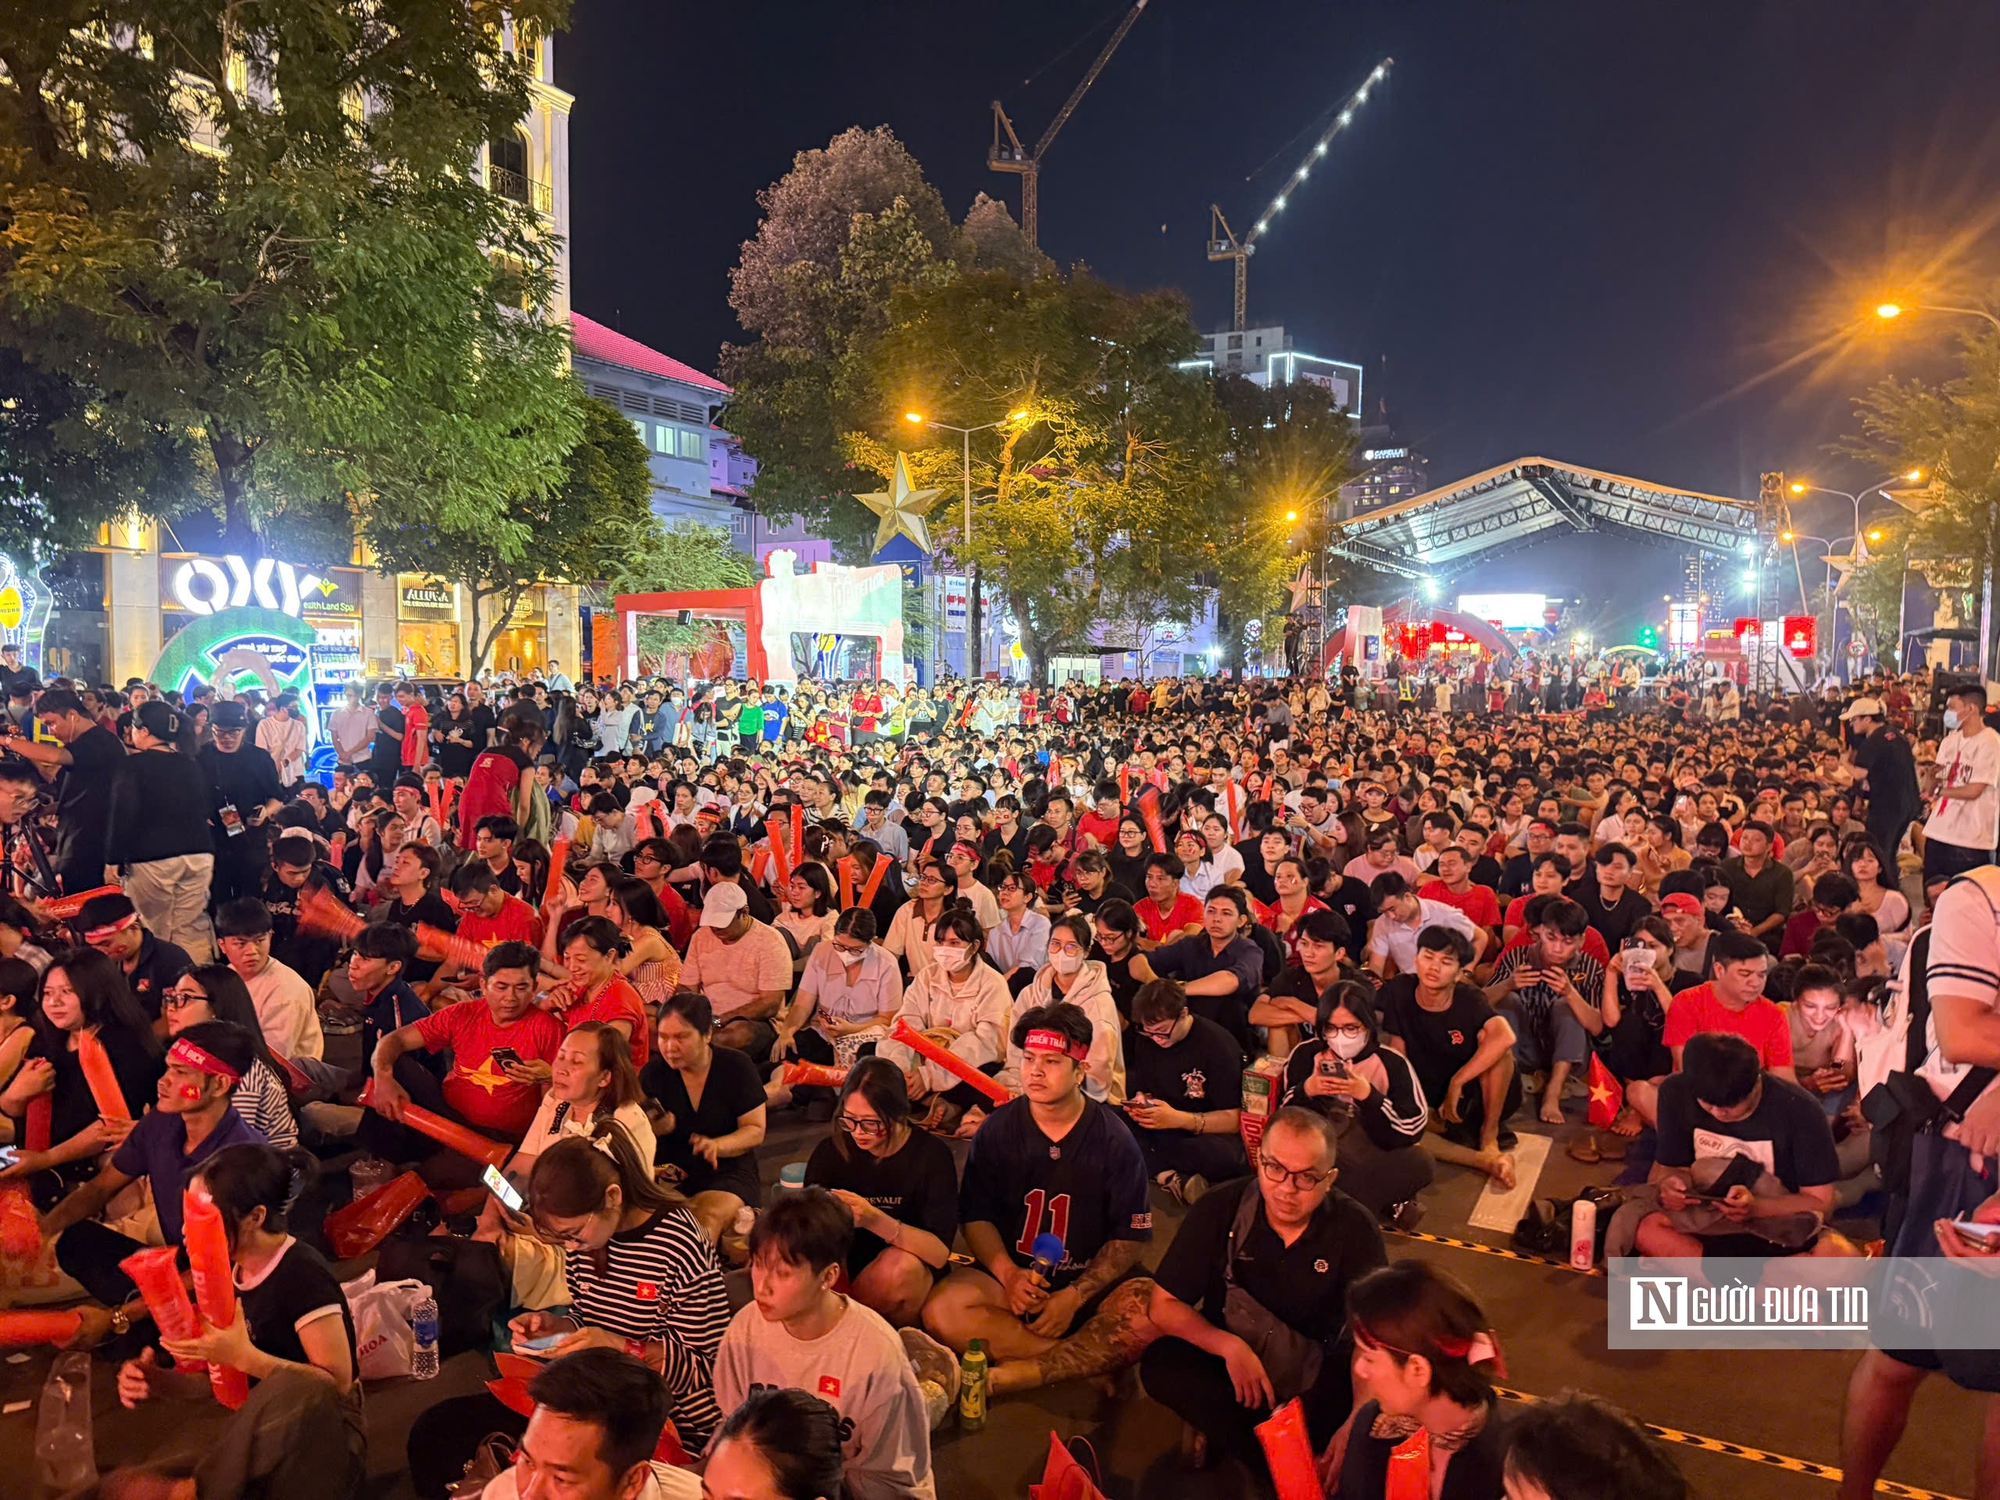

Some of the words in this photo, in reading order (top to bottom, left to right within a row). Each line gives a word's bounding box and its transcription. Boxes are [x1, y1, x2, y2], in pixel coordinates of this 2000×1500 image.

[175, 555, 322, 618] OXY
[303, 602, 321, 610] ealth
[322, 602, 340, 611] Land
[340, 603, 355, 613] Spa
[1029, 1033, 1048, 1045] CHIẾN
[1016, 1188, 1071, 1263] 11
[359, 1334, 388, 1356] HOA
